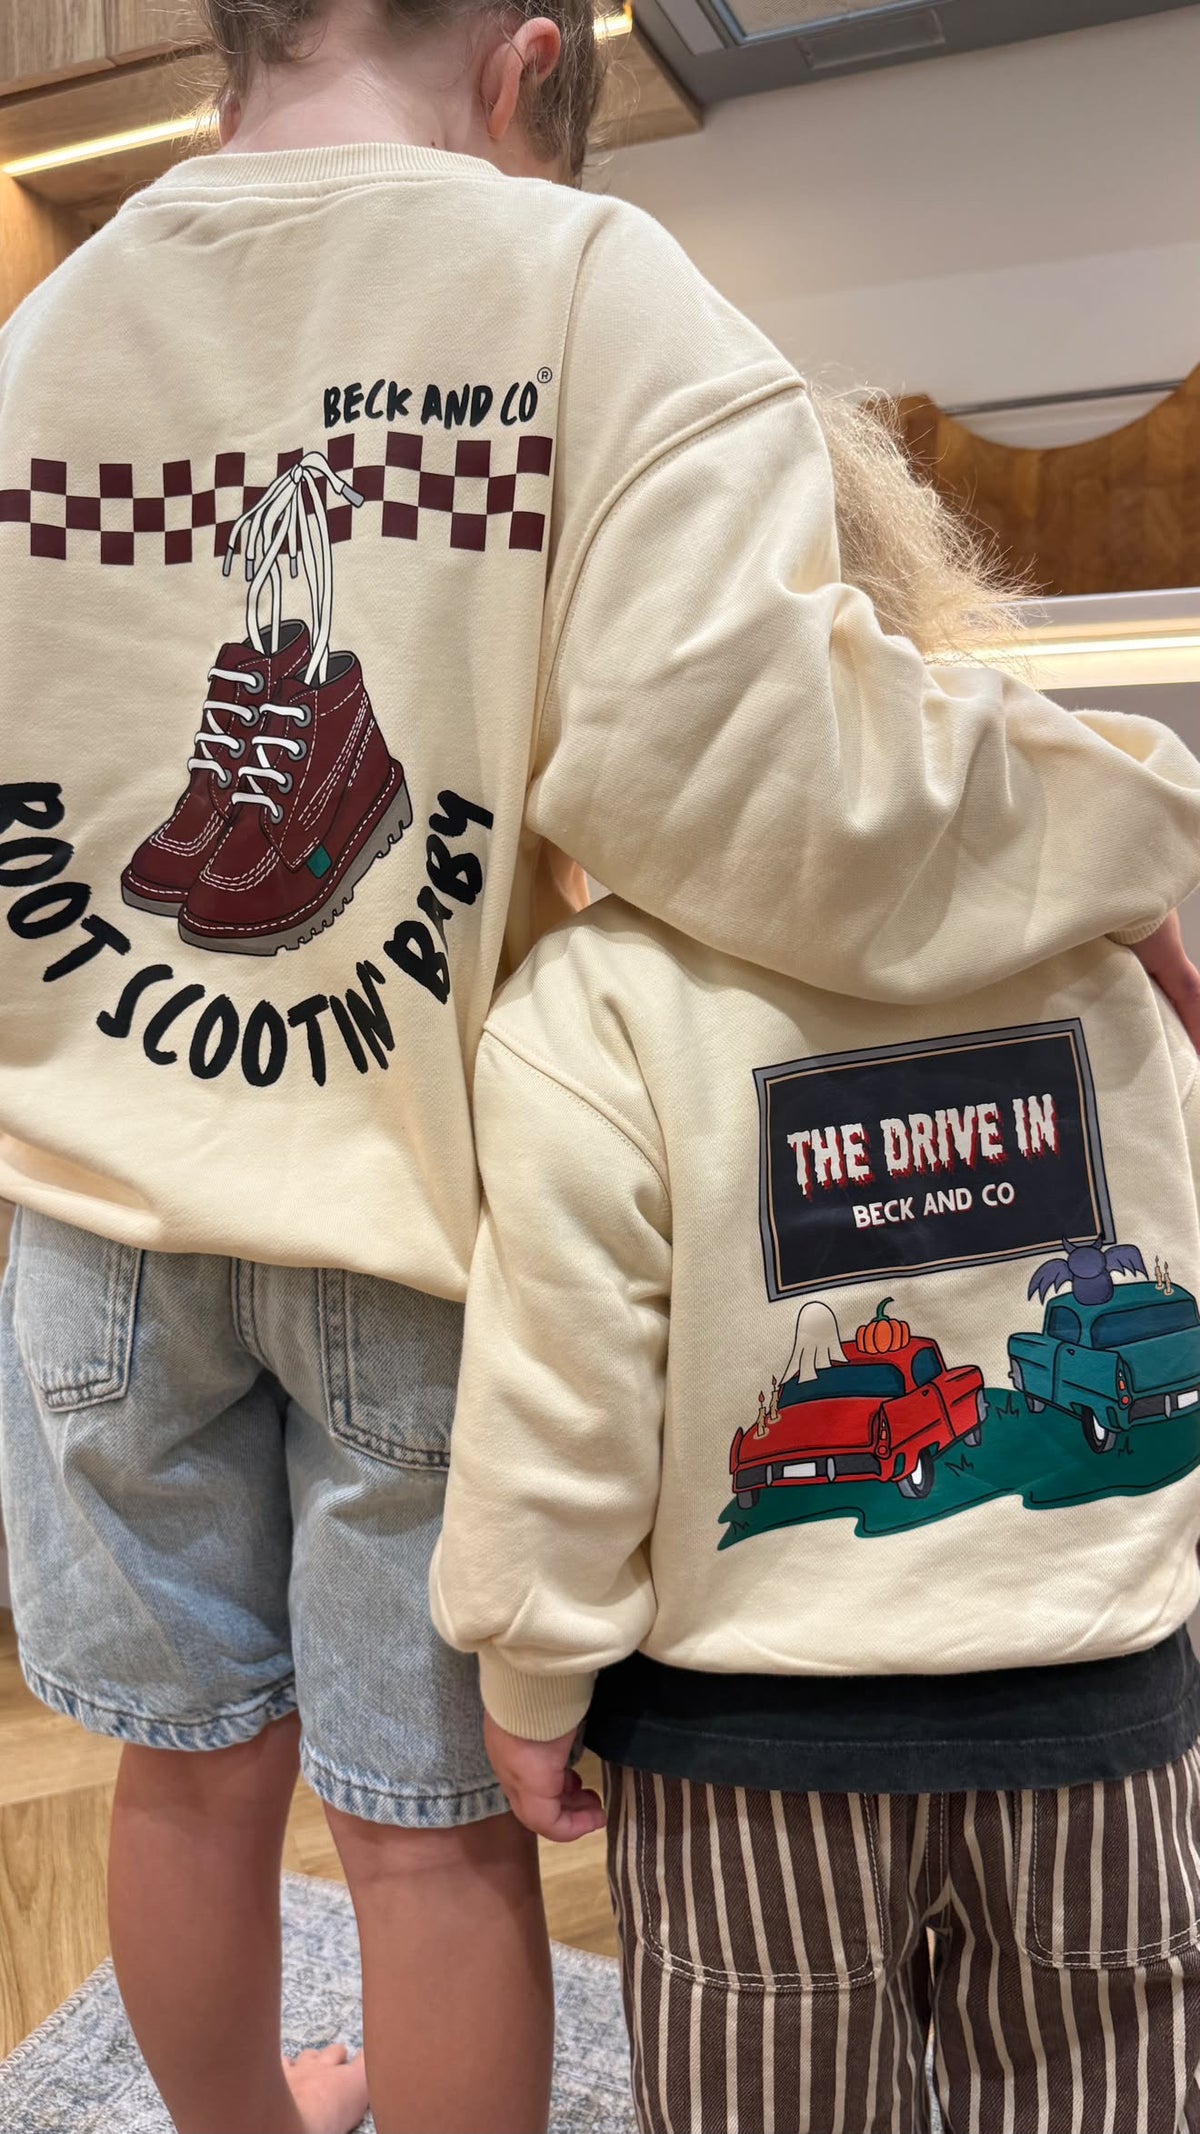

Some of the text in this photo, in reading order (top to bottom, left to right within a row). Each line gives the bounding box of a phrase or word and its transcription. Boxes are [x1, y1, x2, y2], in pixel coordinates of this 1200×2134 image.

[324, 378, 412, 428] BECK
[420, 383, 494, 430] AND
[786, 1093, 1060, 1202] THE DRIVE IN
[852, 1181, 1015, 1229] BECK AND CO
